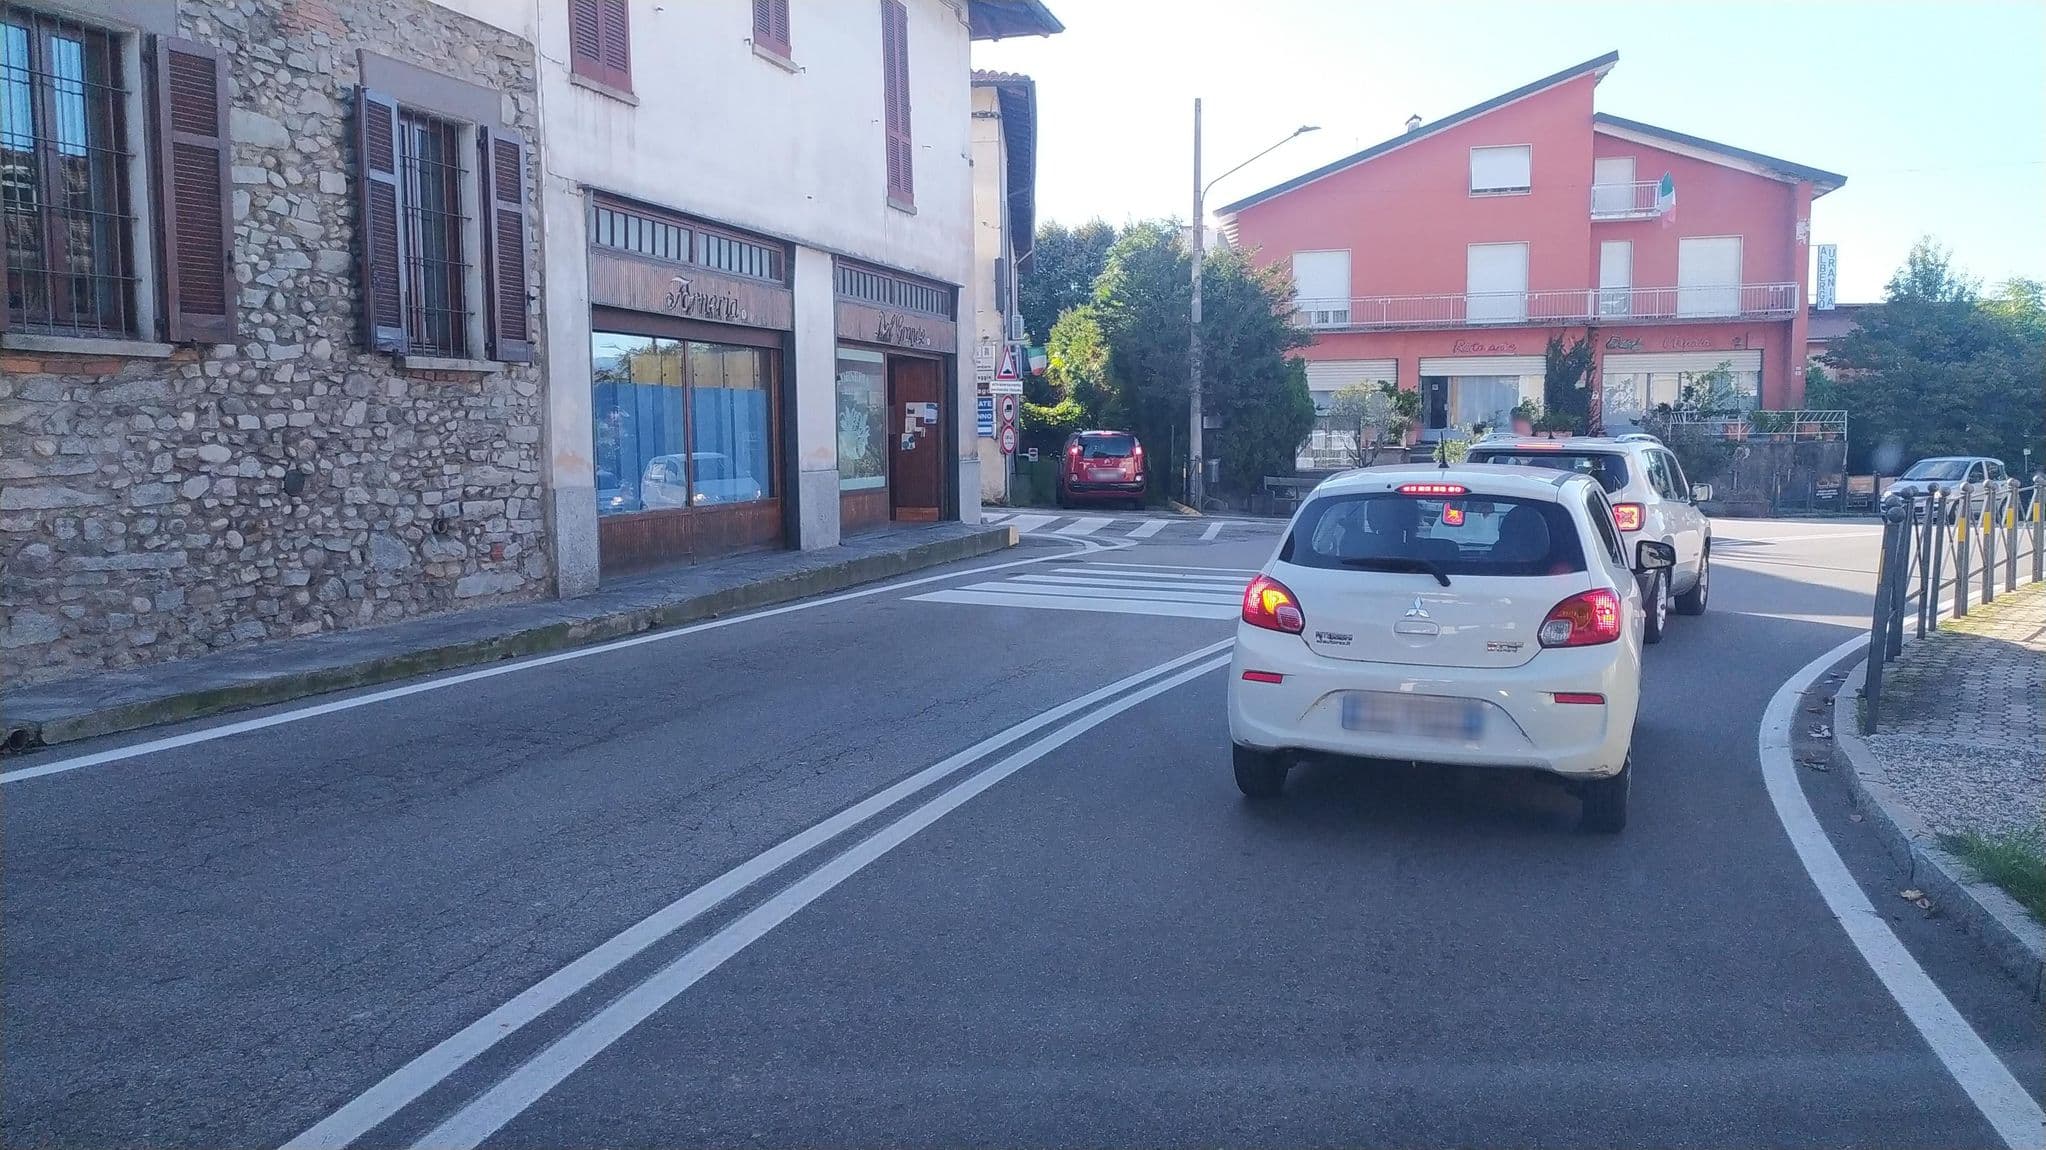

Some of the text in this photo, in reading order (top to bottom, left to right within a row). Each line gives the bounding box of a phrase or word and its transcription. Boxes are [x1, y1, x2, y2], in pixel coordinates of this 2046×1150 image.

[665, 275, 739, 319] Armeria
[1819, 246, 1828, 309] ALBERGO
[1827, 248, 1836, 307] URANIA
